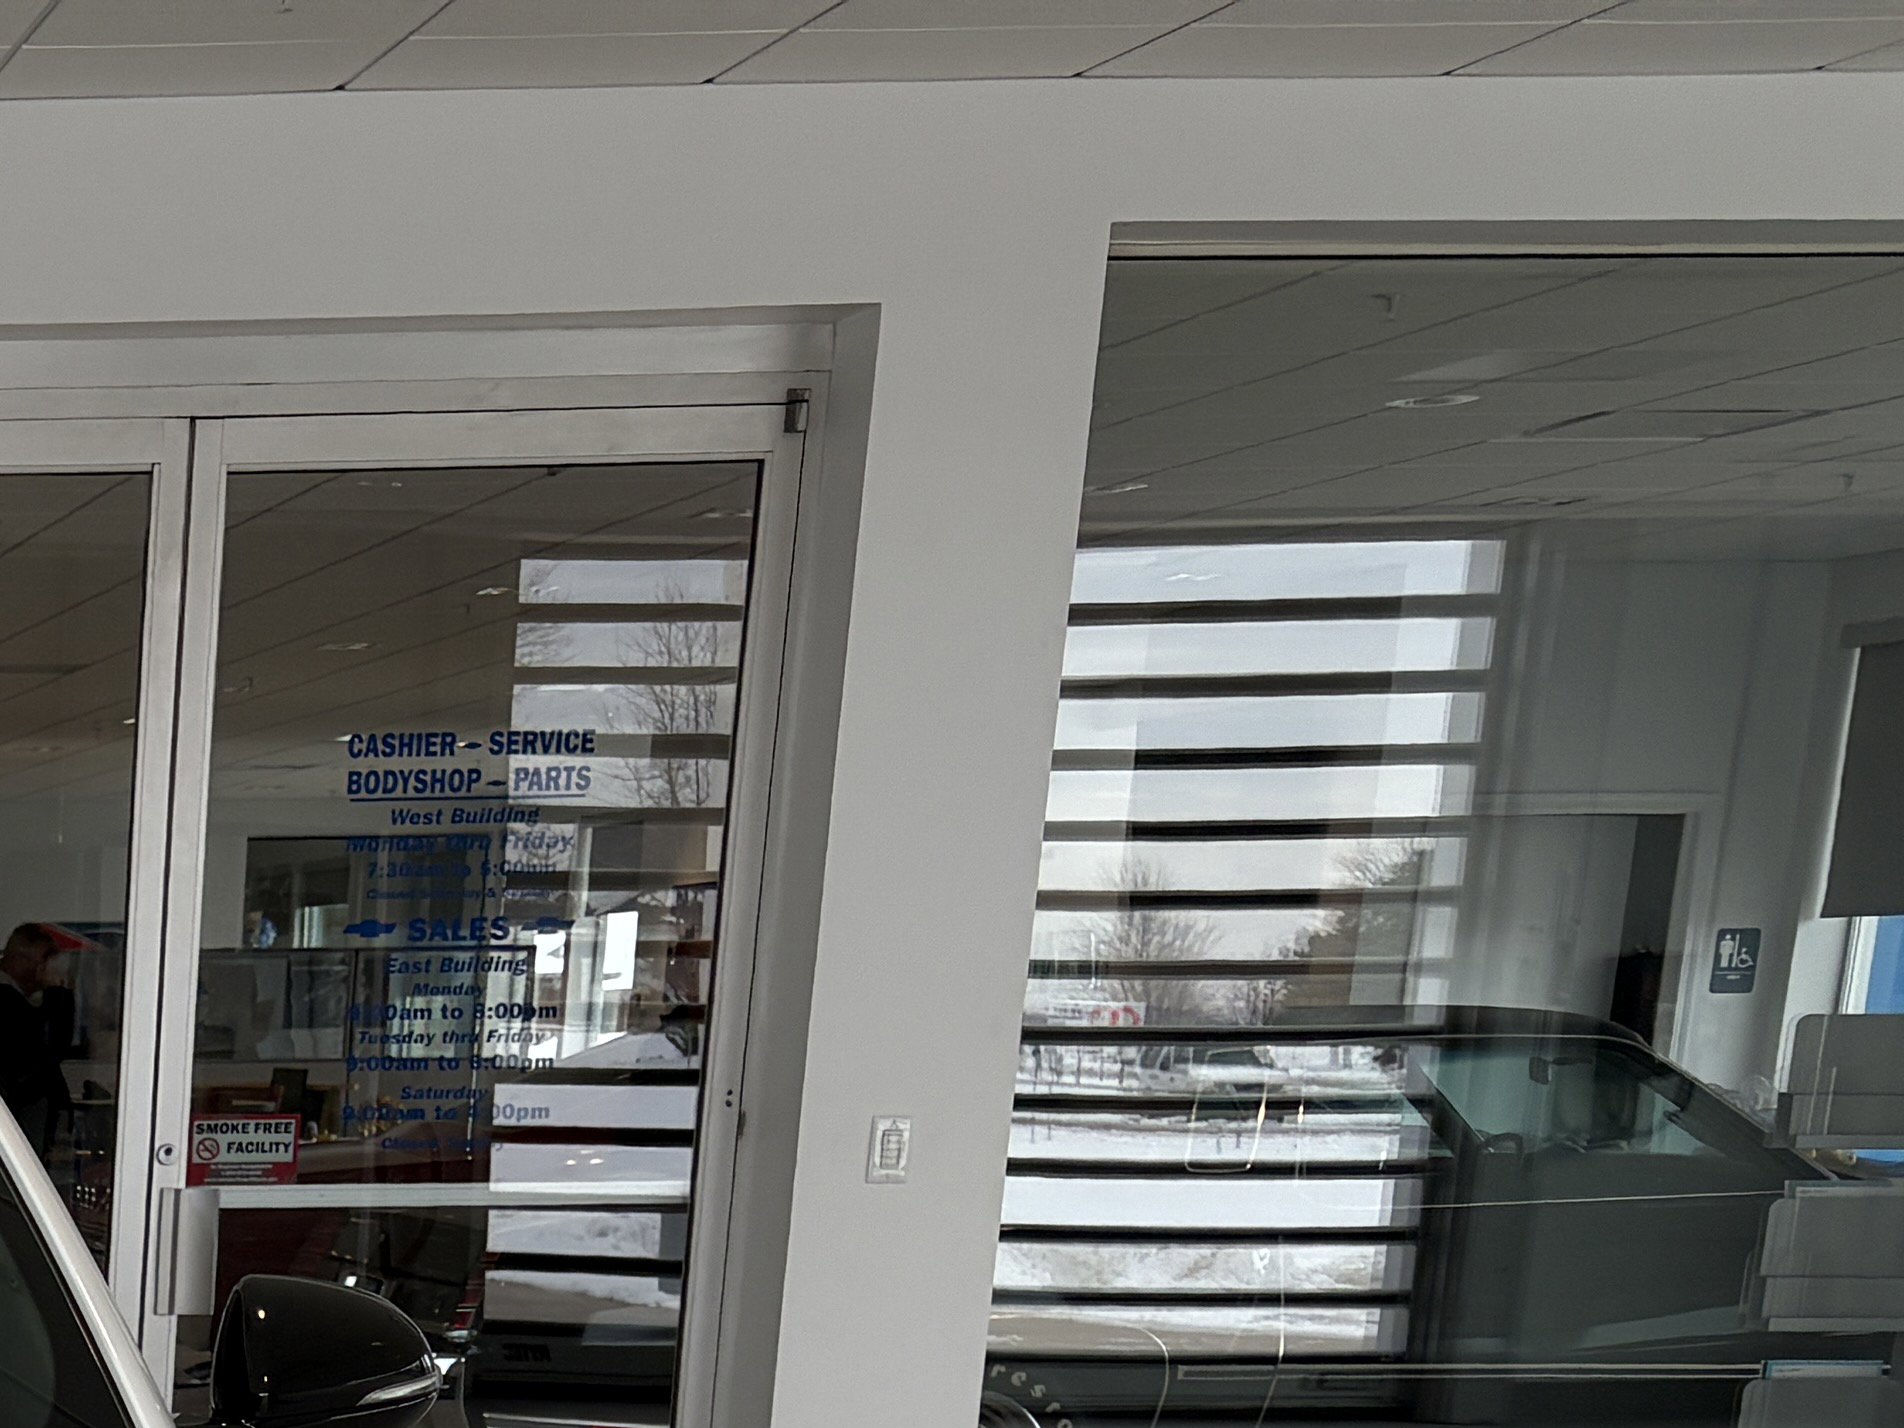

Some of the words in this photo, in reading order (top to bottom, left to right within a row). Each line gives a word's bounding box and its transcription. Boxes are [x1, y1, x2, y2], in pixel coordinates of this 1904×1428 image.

[347, 732, 457, 759] CASHIER
[488, 729, 596, 756] SERVICE
[347, 768, 482, 796] BODYSHOP
[513, 766, 592, 792] PARTS
[391, 808, 442, 825] West
[451, 806, 541, 825] Building
[502, 830, 574, 854] Friday
[407, 916, 510, 942] SALES
[386, 958, 432, 974] East
[439, 956, 527, 976] Building
[412, 983, 486, 998] Monday
[442, 1004, 463, 1019] to
[358, 1031, 436, 1046] Tuesday
[442, 1030, 480, 1044] thru
[485, 1029, 544, 1046] Friday
[438, 1055, 460, 1071] to
[400, 1085, 489, 1102] Saturday
[195, 1122, 250, 1135] SMOKE
[254, 1122, 294, 1134] FREE
[226, 1142, 292, 1154] FACILITY
